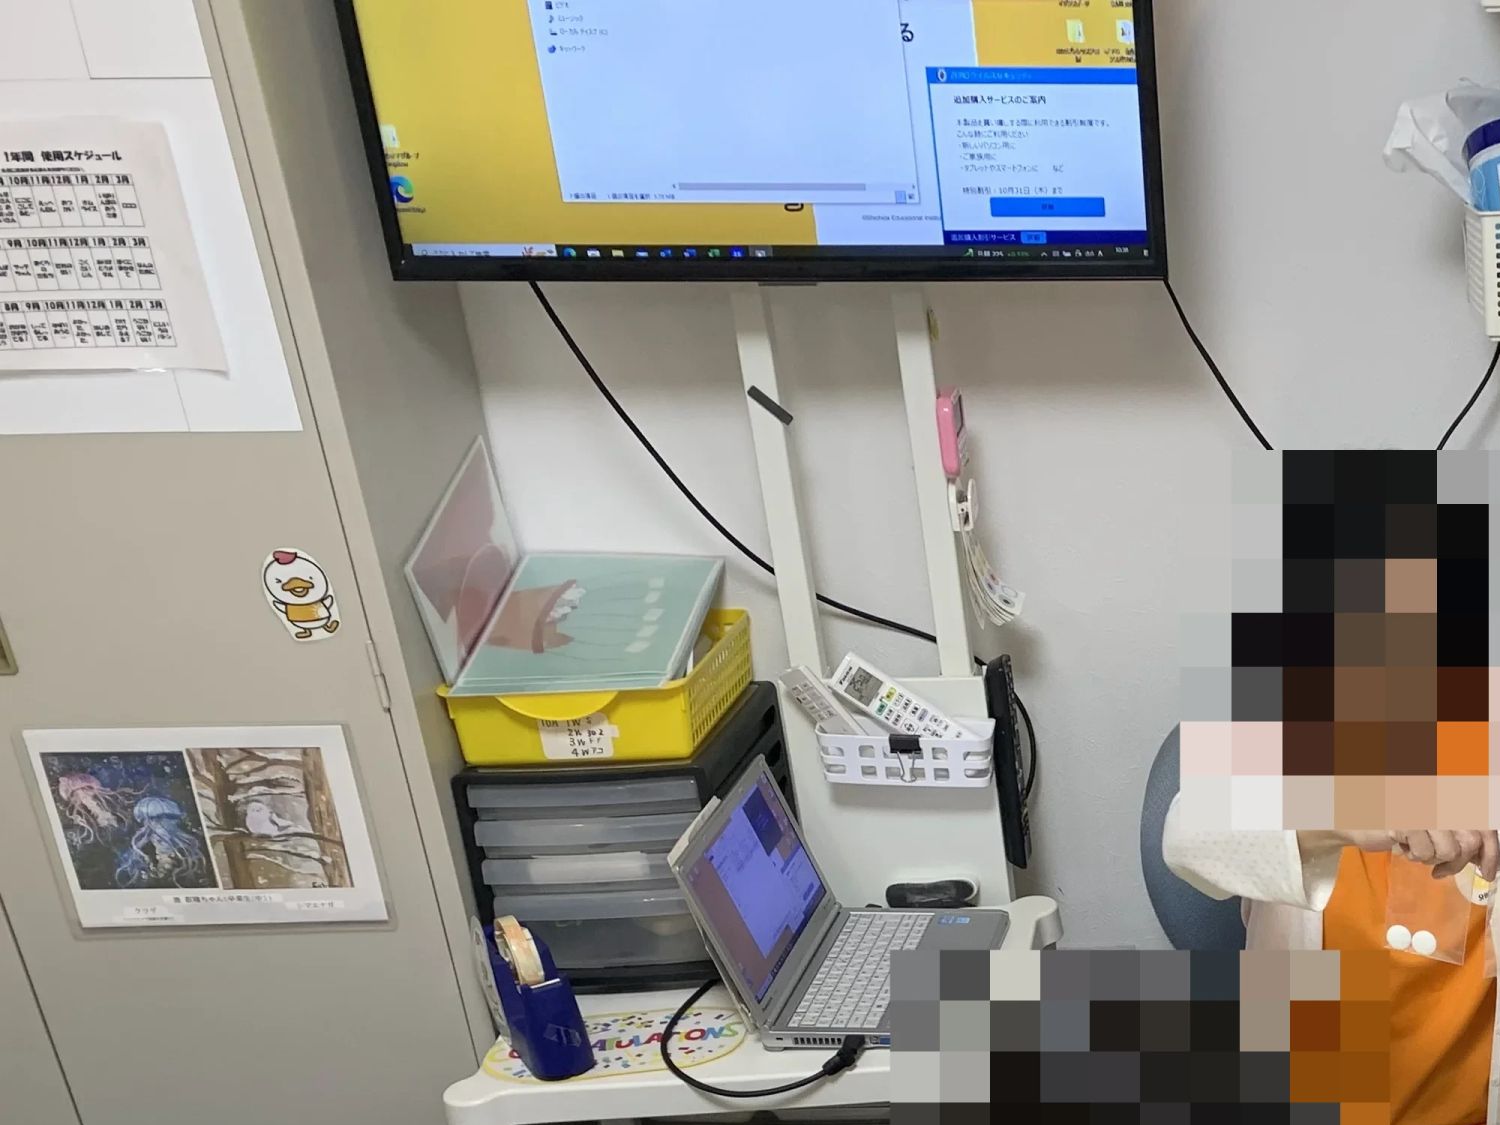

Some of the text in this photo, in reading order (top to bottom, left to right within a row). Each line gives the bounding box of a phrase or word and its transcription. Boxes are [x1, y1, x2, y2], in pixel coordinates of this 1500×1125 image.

[953, 95, 1047, 105] 追加購入サービスのご案内
[3, 150, 122, 162] 1年間 使用スケジュール
